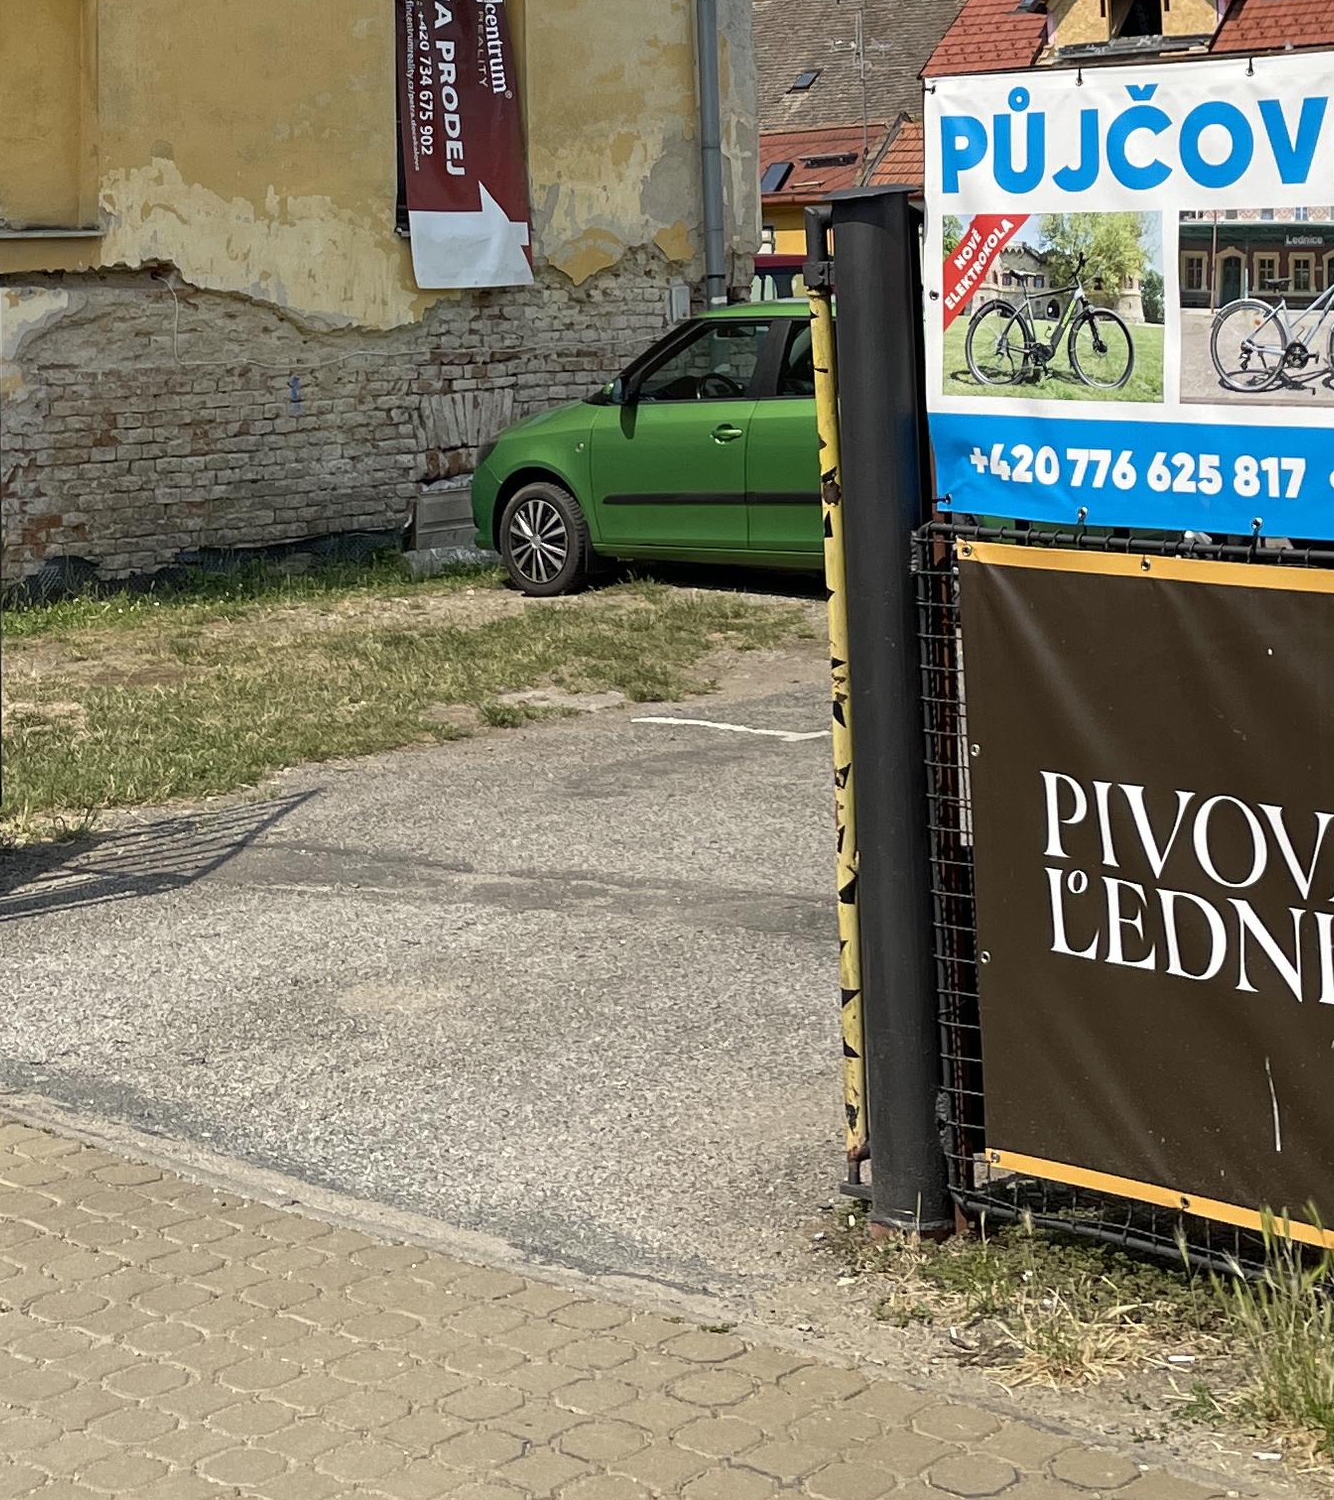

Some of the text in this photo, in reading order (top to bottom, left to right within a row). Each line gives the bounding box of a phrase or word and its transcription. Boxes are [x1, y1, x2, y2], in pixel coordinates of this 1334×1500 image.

[417, 11, 430, 51] +420
[476, 10, 489, 89] REALITY
[419, 56, 433, 86] 734
[420, 90, 433, 121] 675
[435, 40, 466, 177] PRODEJ
[421, 125, 433, 156] 902
[944, 218, 1015, 310] ELEKTROKOLA
[970, 443, 1060, 485] +420
[1066, 447, 1137, 490] 776
[1147, 451, 1223, 495] 625
[1233, 455, 1306, 499] 817
